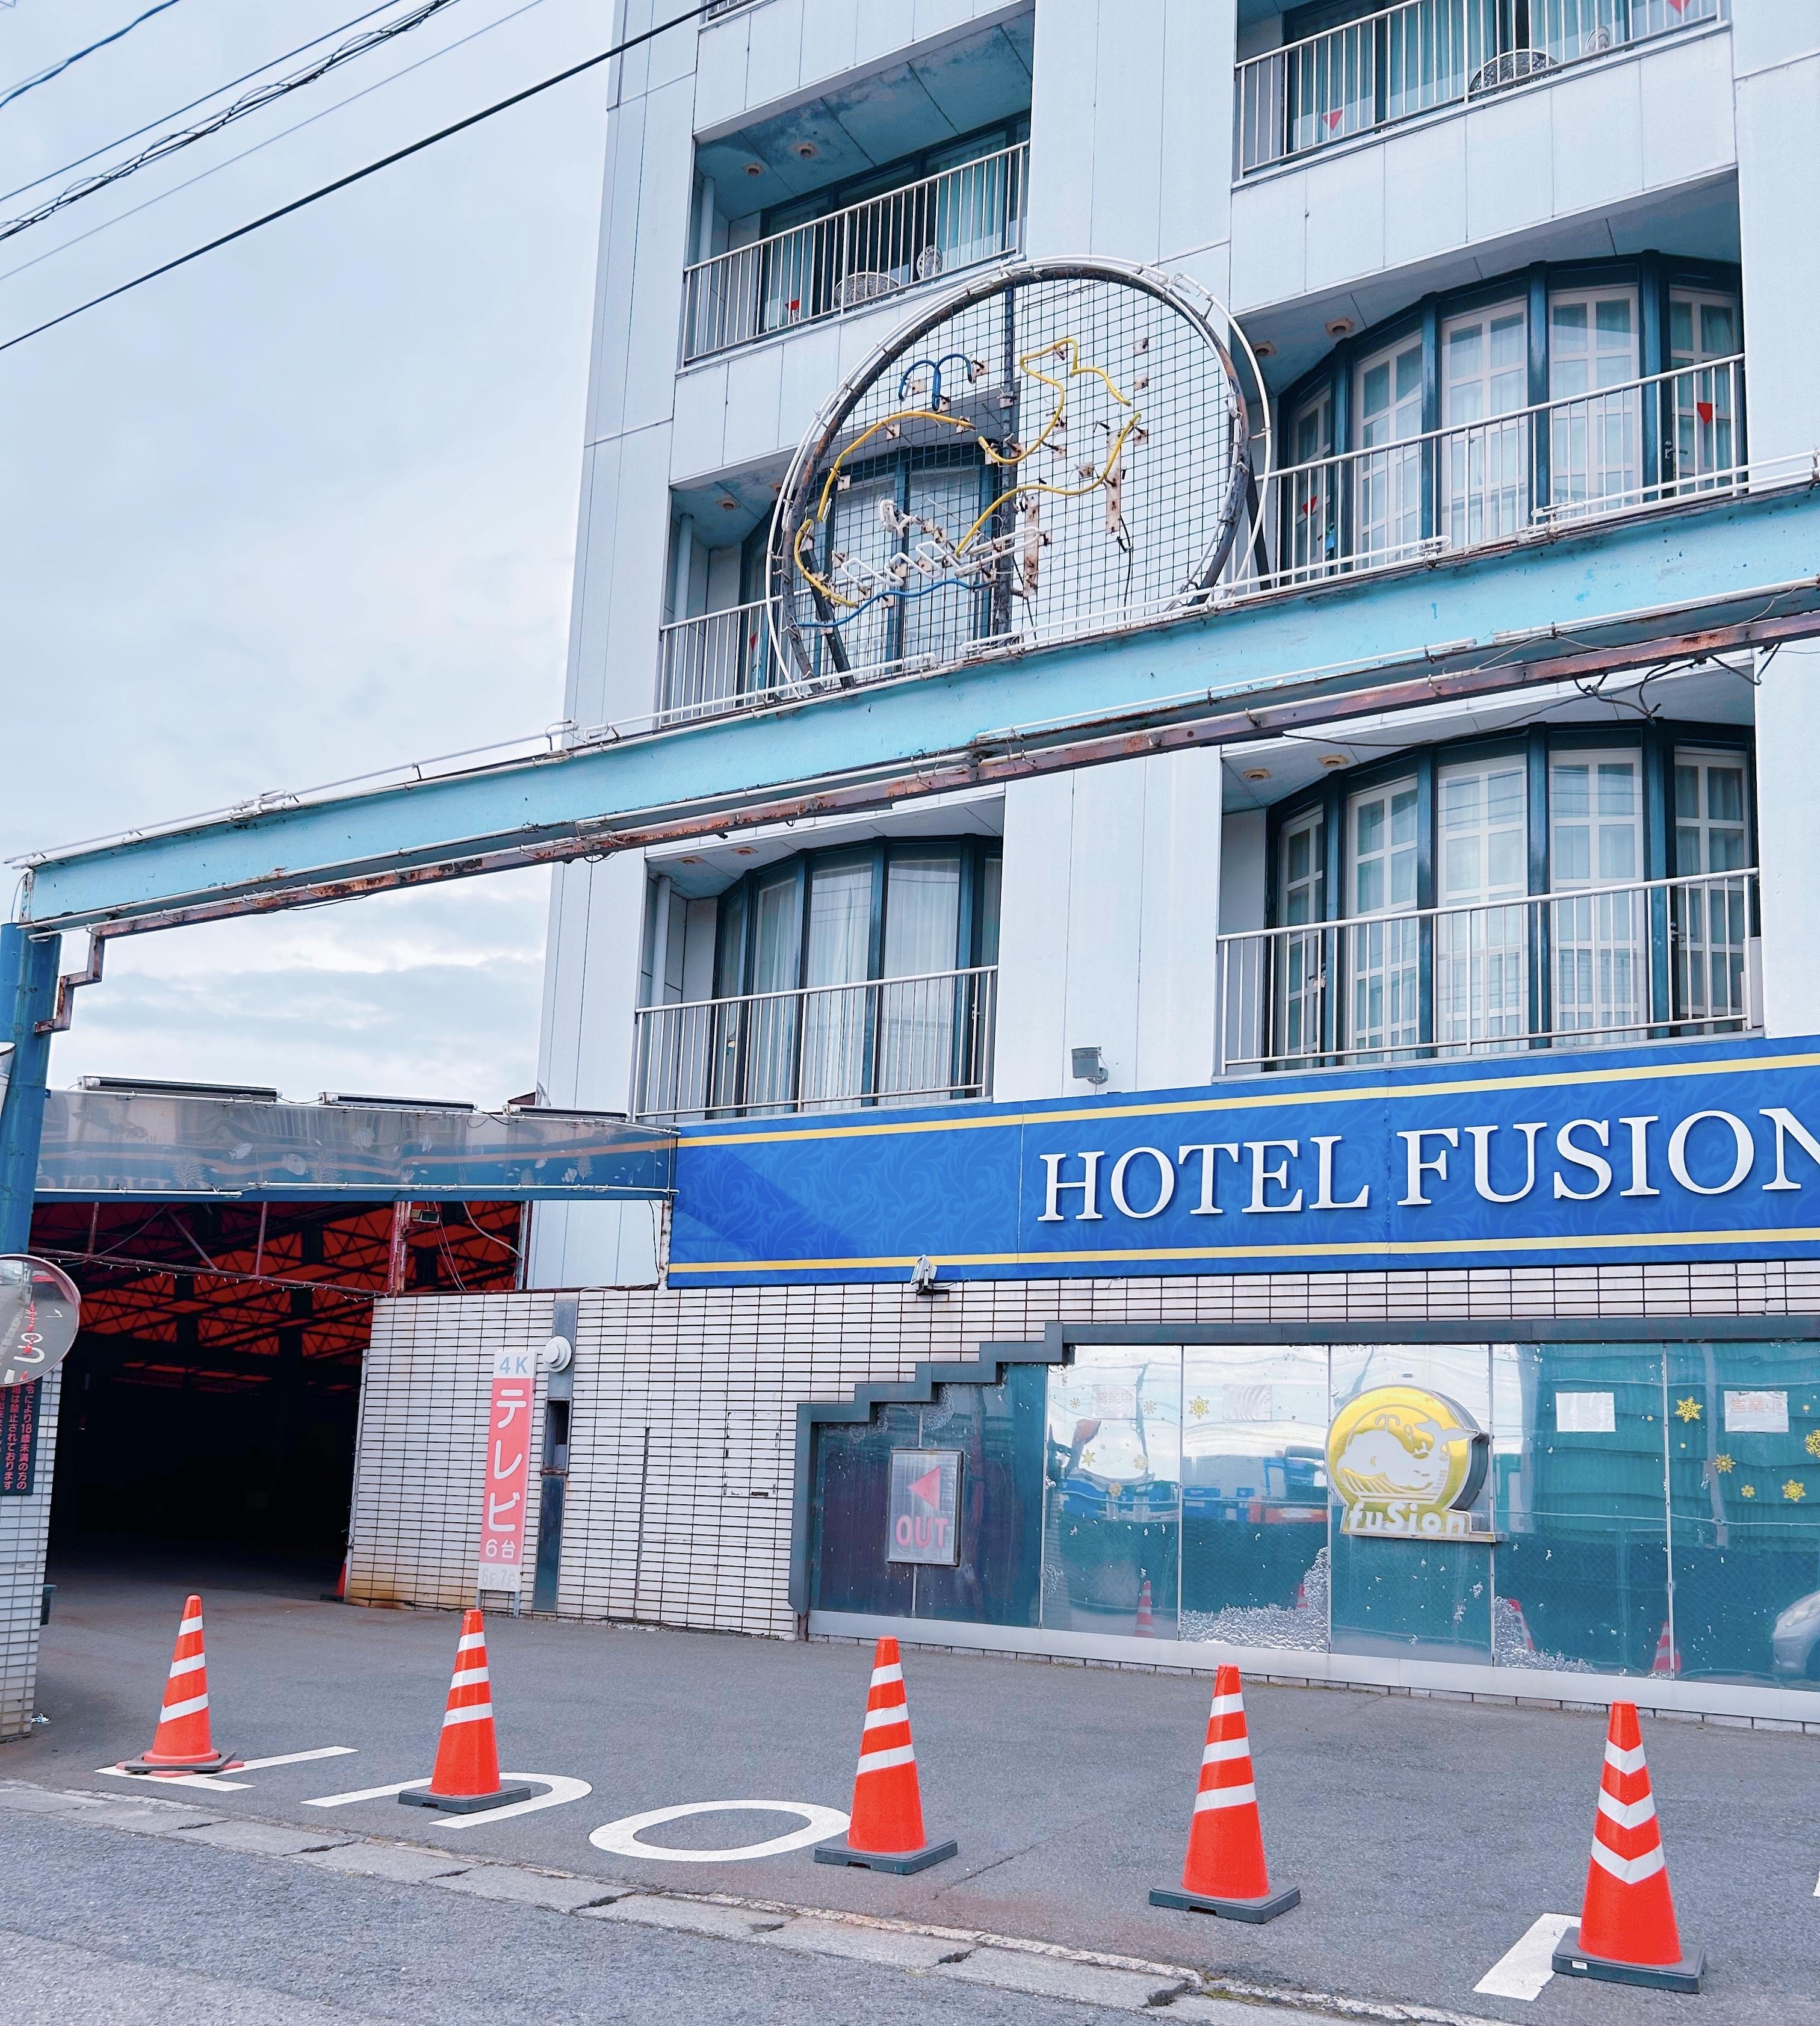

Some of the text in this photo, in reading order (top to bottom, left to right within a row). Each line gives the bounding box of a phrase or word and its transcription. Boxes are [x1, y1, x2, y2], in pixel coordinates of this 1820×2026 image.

[1037, 1107, 1820, 1221] HOTEL FUSION
[499, 1356, 529, 1375] 4K
[488, 1389, 527, 1532] テレビ
[896, 1514, 949, 1548] OUT
[485, 1538, 516, 1559] 6台
